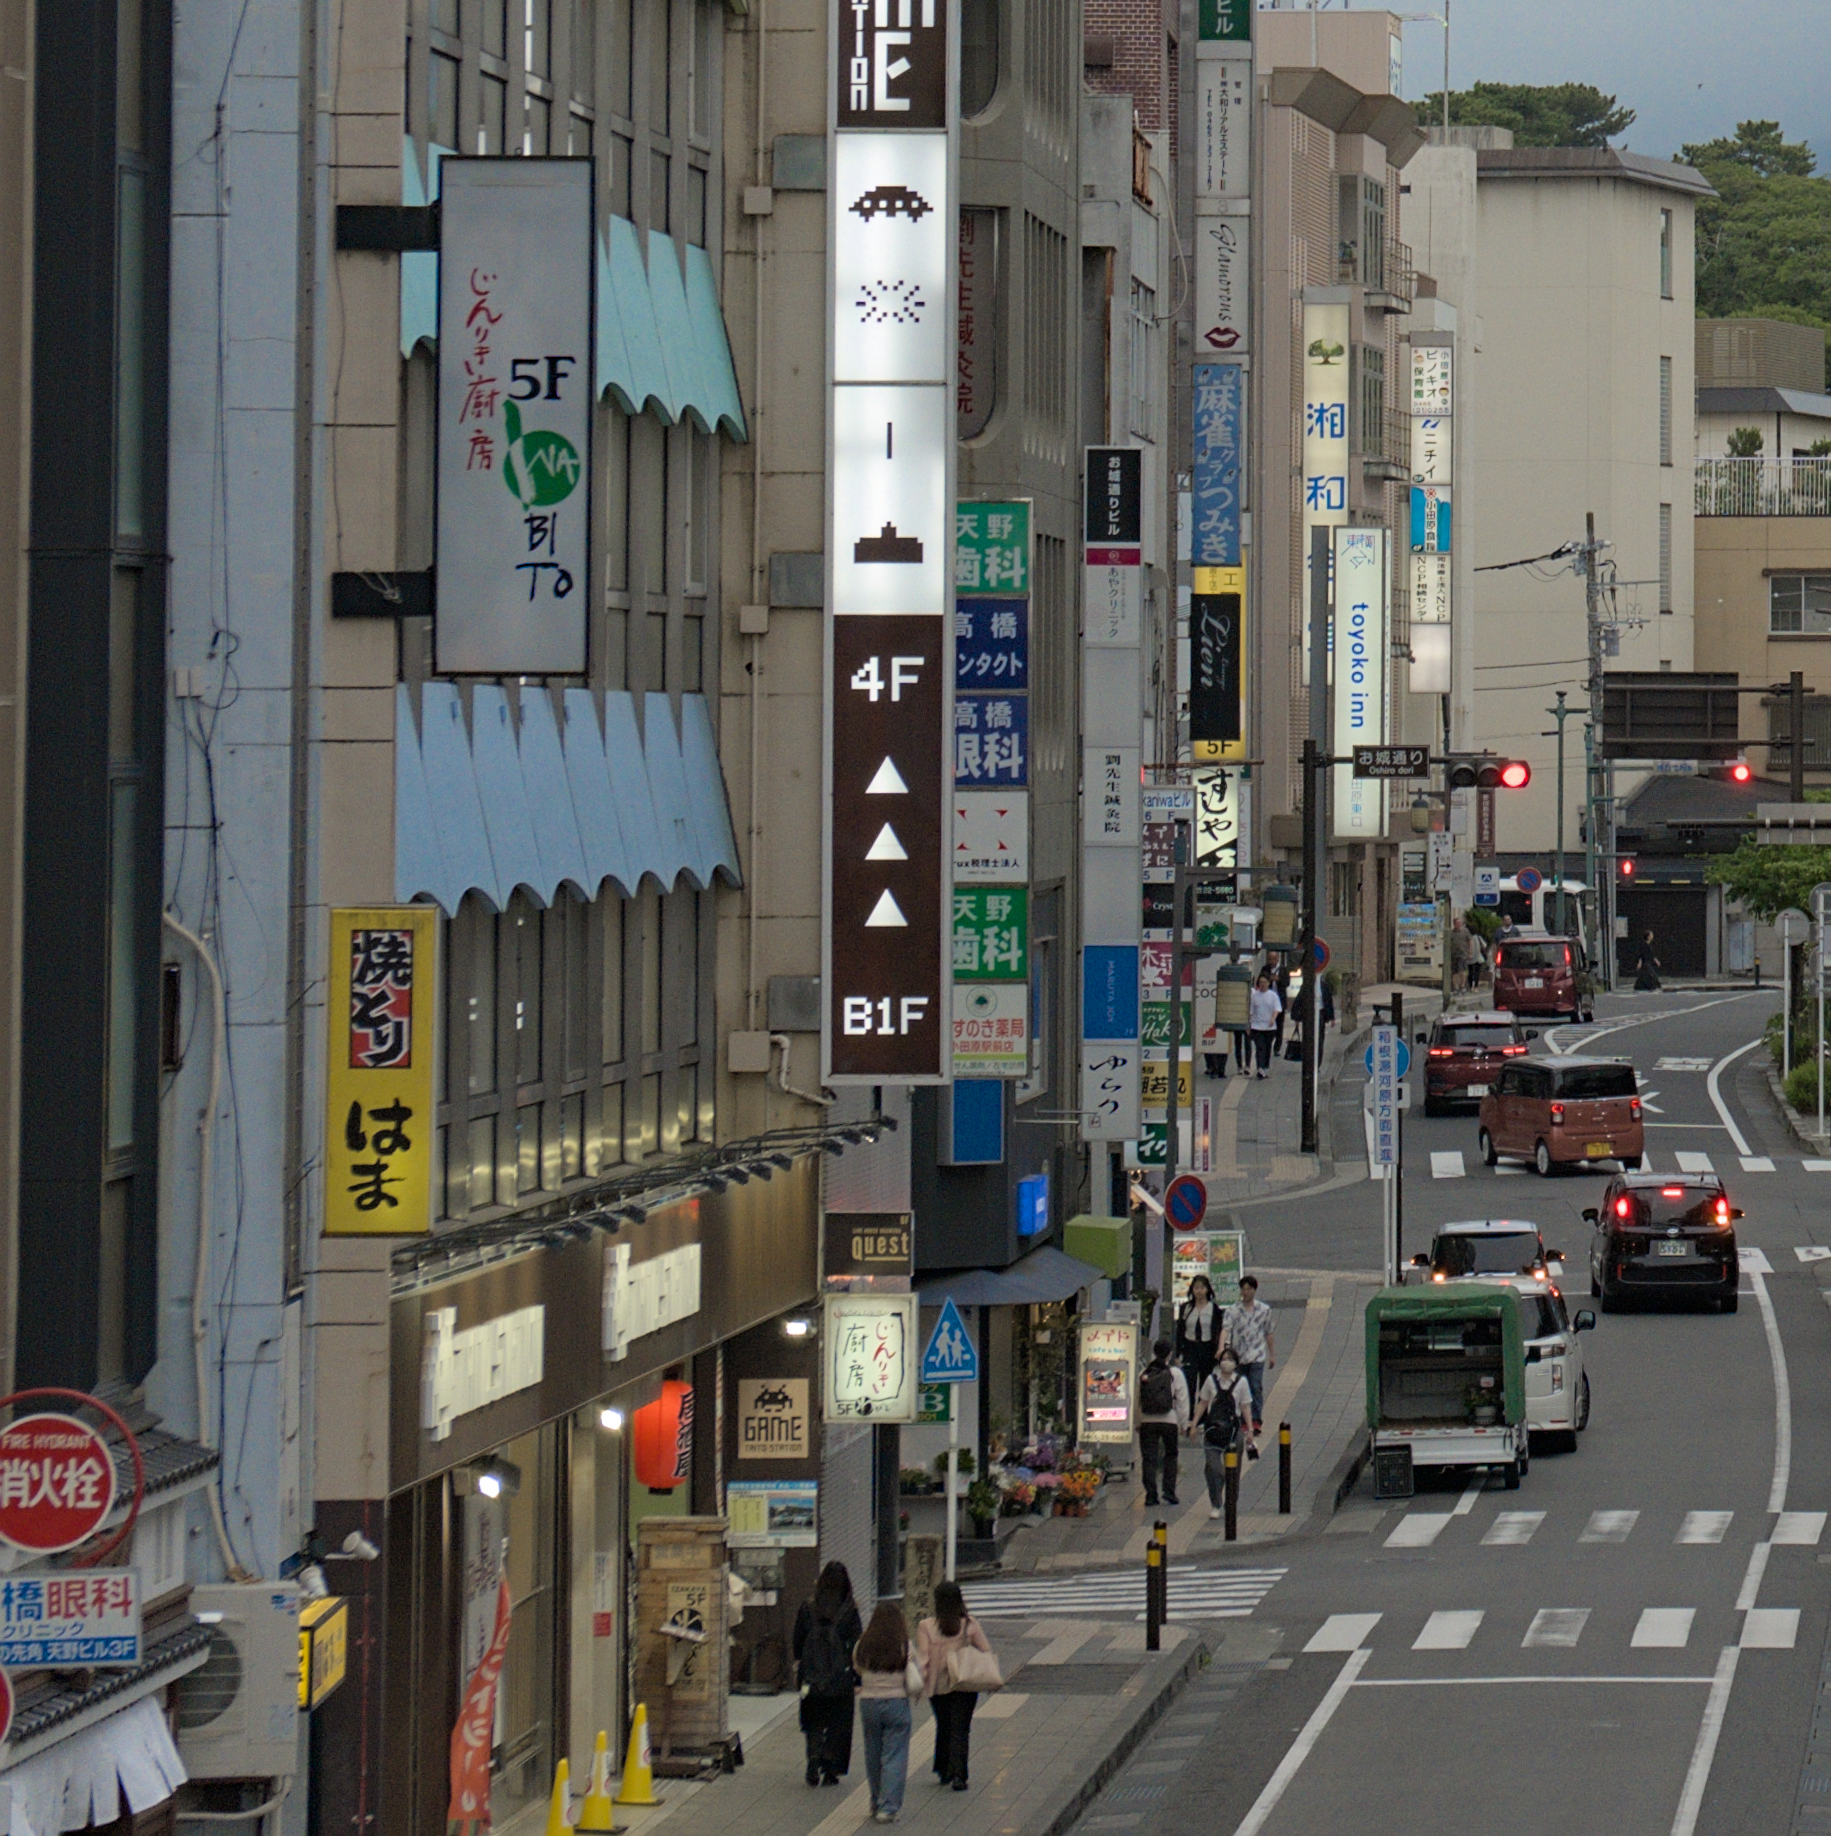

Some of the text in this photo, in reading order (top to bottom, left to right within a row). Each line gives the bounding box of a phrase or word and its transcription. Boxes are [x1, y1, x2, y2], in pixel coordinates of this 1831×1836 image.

[1209, 224, 1240, 322] Glamorous
[509, 356, 576, 402] 5F
[1426, 351, 1438, 399] ピノキオ
[1197, 382, 1237, 449] 麻雀
[1424, 432, 1438, 480] ニチイ
[955, 514, 1014, 540] 天野
[1198, 488, 1235, 563] つみき
[850, 655, 926, 702] 4F
[1348, 602, 1370, 729] toyoko inn
[1358, 750, 1425, 766] お城通り
[1369, 766, 1415, 776] Oshiro dori
[953, 858, 1020, 868] ux税理士法人
[953, 894, 1012, 922] 天野
[351, 931, 413, 1068] 焼とり
[843, 996, 929, 1036] B1F
[1377, 1030, 1393, 1163] 箱根湯河原方面直進
[345, 1097, 413, 1212] はま
[1, 1432, 91, 1451] FIRE HYDRANT
[745, 1416, 802, 1442] GAME
[0, 1459, 103, 1511] 消火栓
[0, 1578, 133, 1623] 橋眼科
